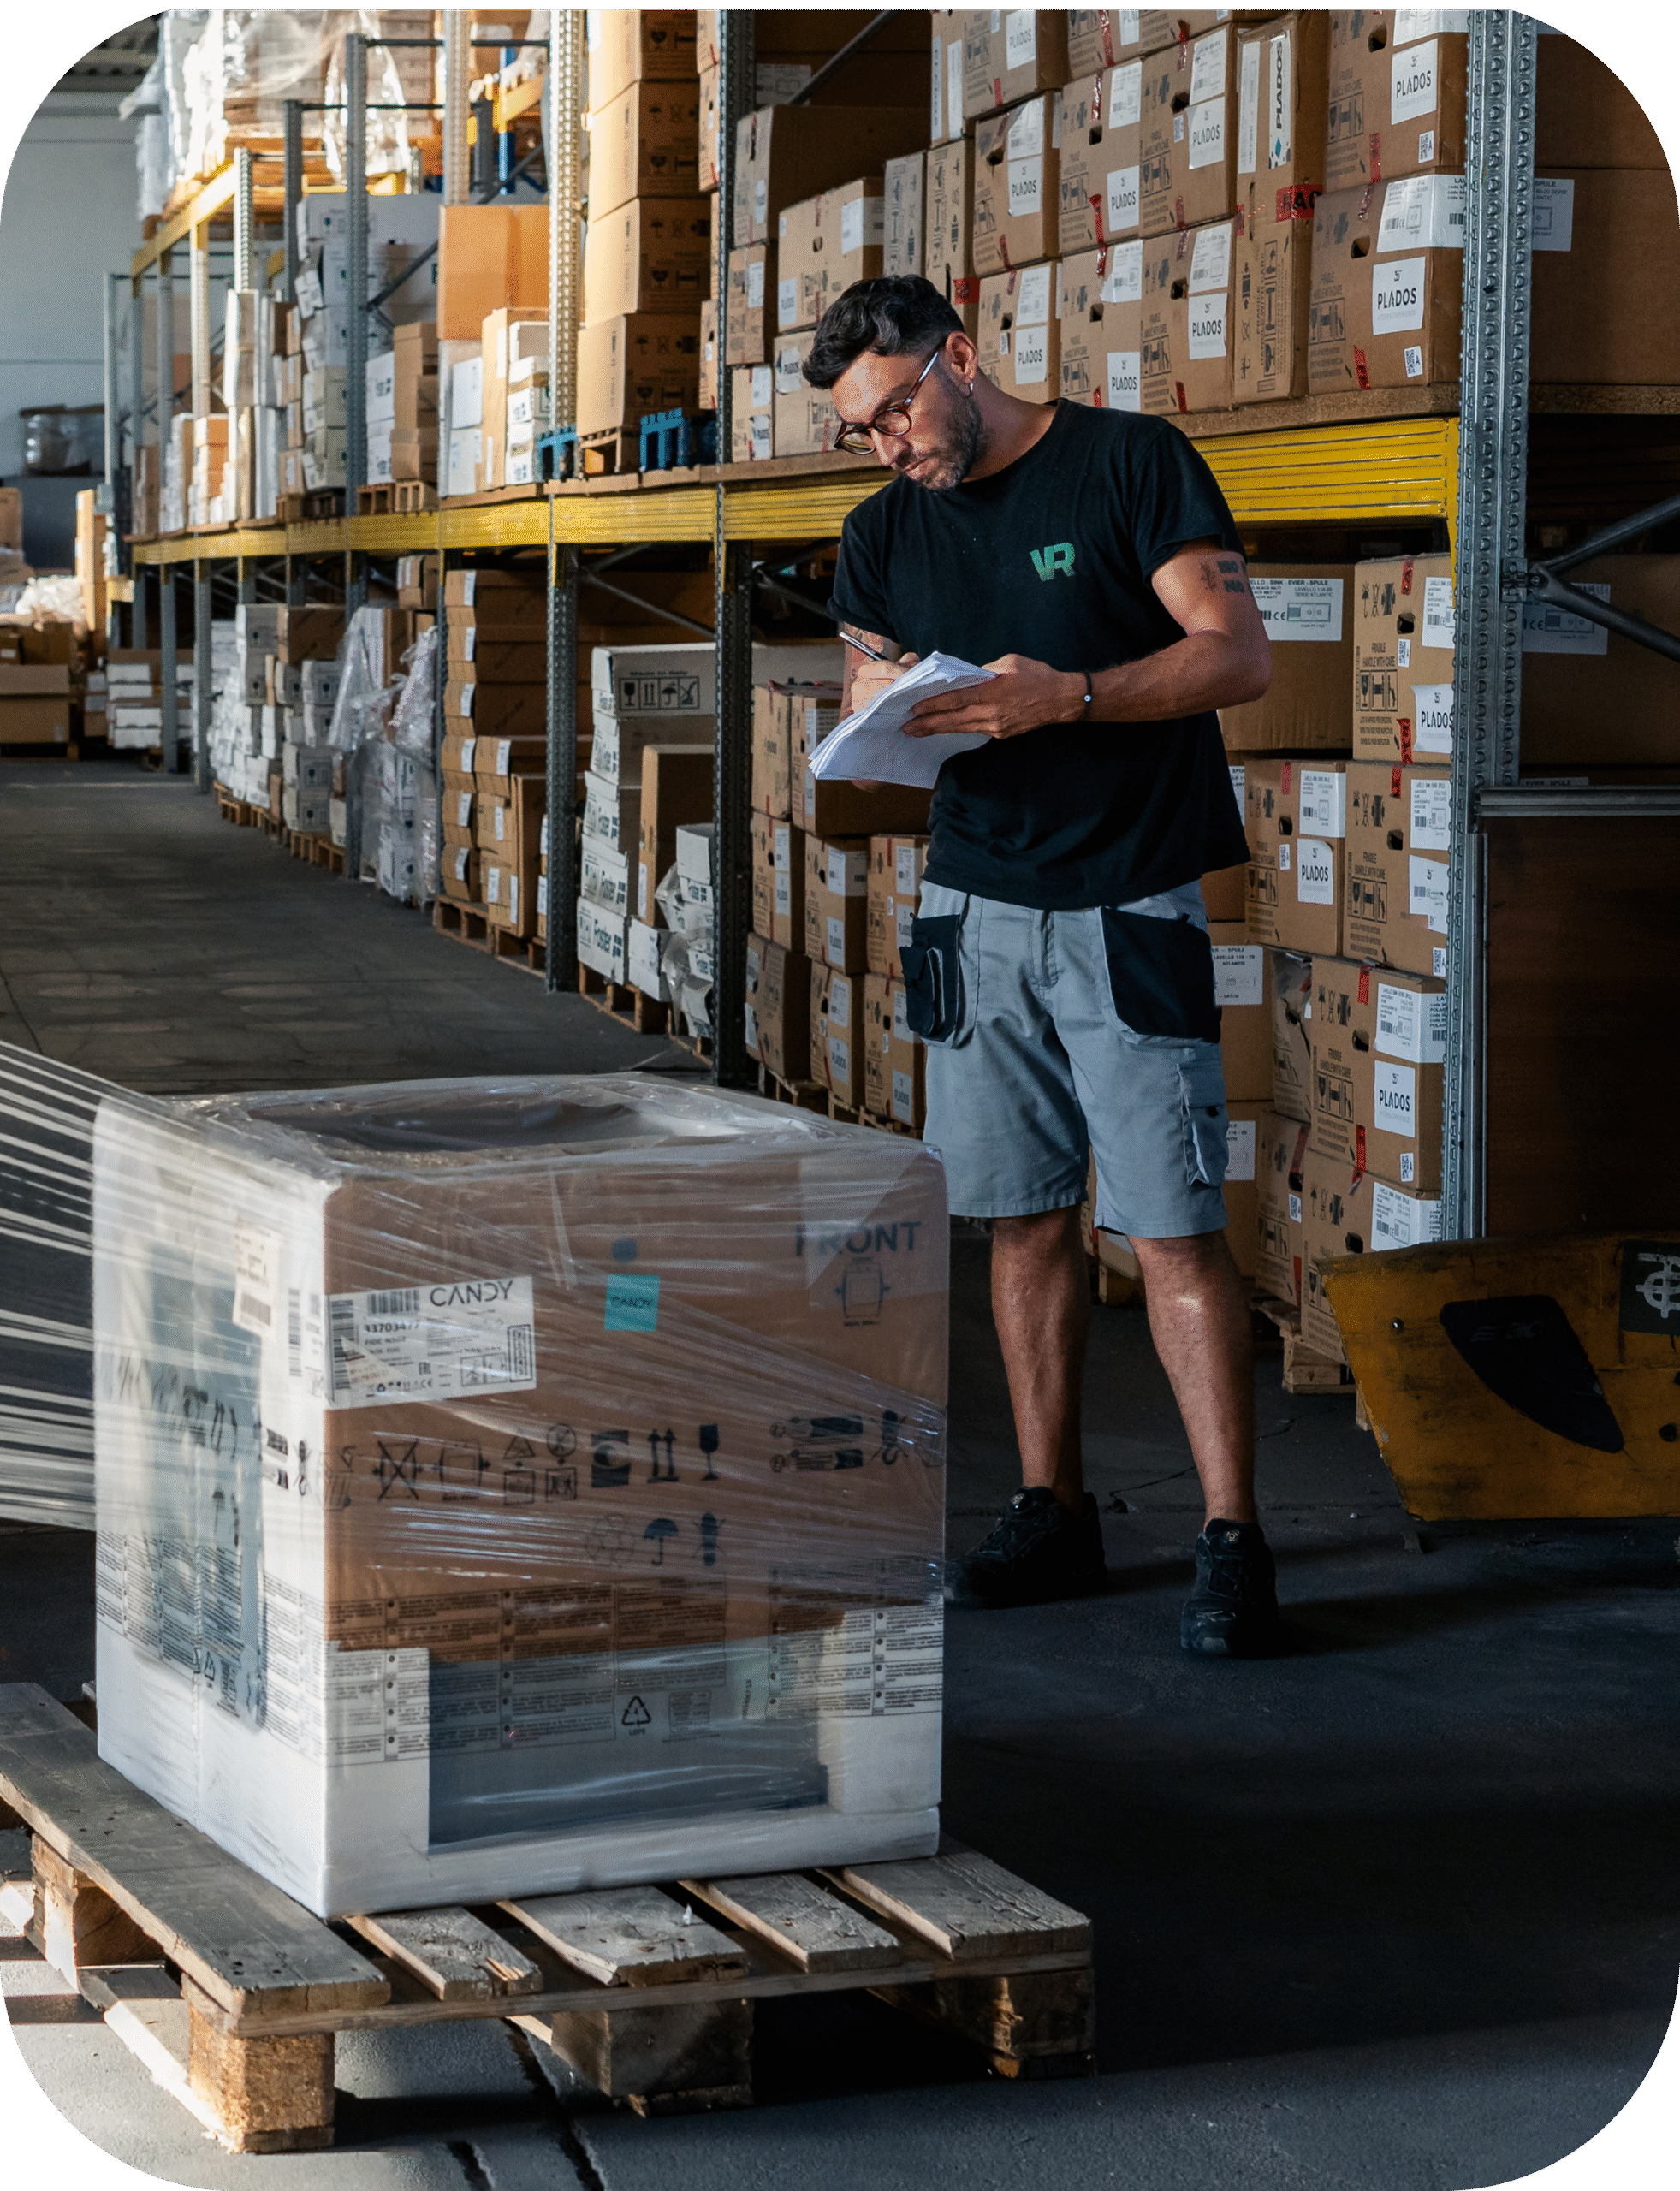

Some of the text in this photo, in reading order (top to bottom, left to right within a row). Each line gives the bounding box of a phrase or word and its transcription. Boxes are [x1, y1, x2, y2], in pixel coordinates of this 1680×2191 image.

[1396, 69, 1432, 98] PLADOS
[1192, 124, 1220, 146] PLADOS
[1012, 180, 1037, 197] PLADOS
[1111, 191, 1137, 211] PLADOS
[1377, 288, 1416, 310] PLADOS
[1191, 319, 1223, 338] PLADOS
[1018, 348, 1043, 365] PLADOS
[1111, 376, 1137, 391] PLADOS
[1421, 711, 1454, 730] PLADOS
[1301, 864, 1329, 882] PLADOS
[1379, 1089, 1410, 1113] PLADOS
[430, 1280, 513, 1308] CANDY
